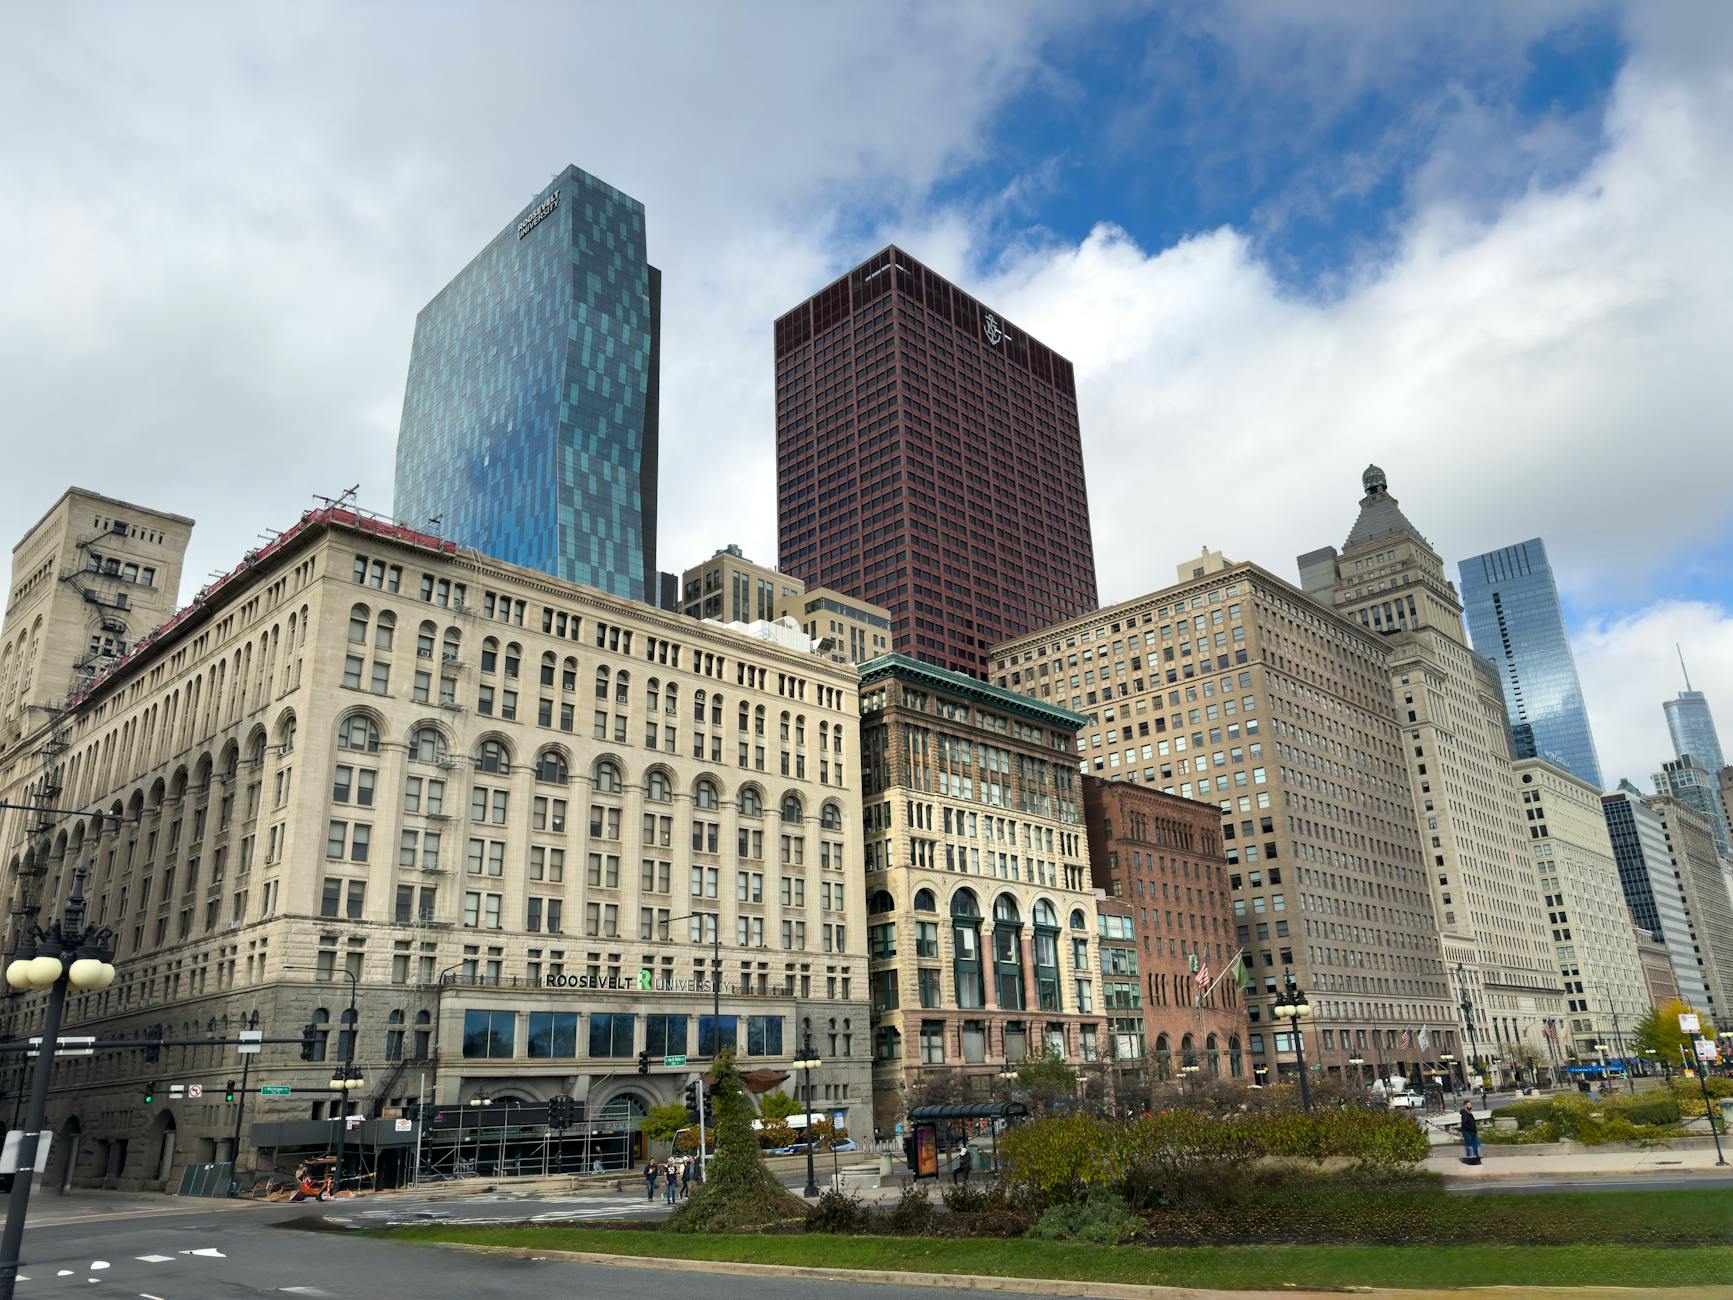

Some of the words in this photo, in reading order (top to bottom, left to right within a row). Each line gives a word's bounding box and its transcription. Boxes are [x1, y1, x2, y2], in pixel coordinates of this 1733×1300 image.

[518, 190, 560, 229] ROOSEVELT
[518, 198, 560, 240] UNIVERSITY
[546, 974, 633, 989] ROOSEVELT
[655, 978, 731, 993] UNIVERSIY
